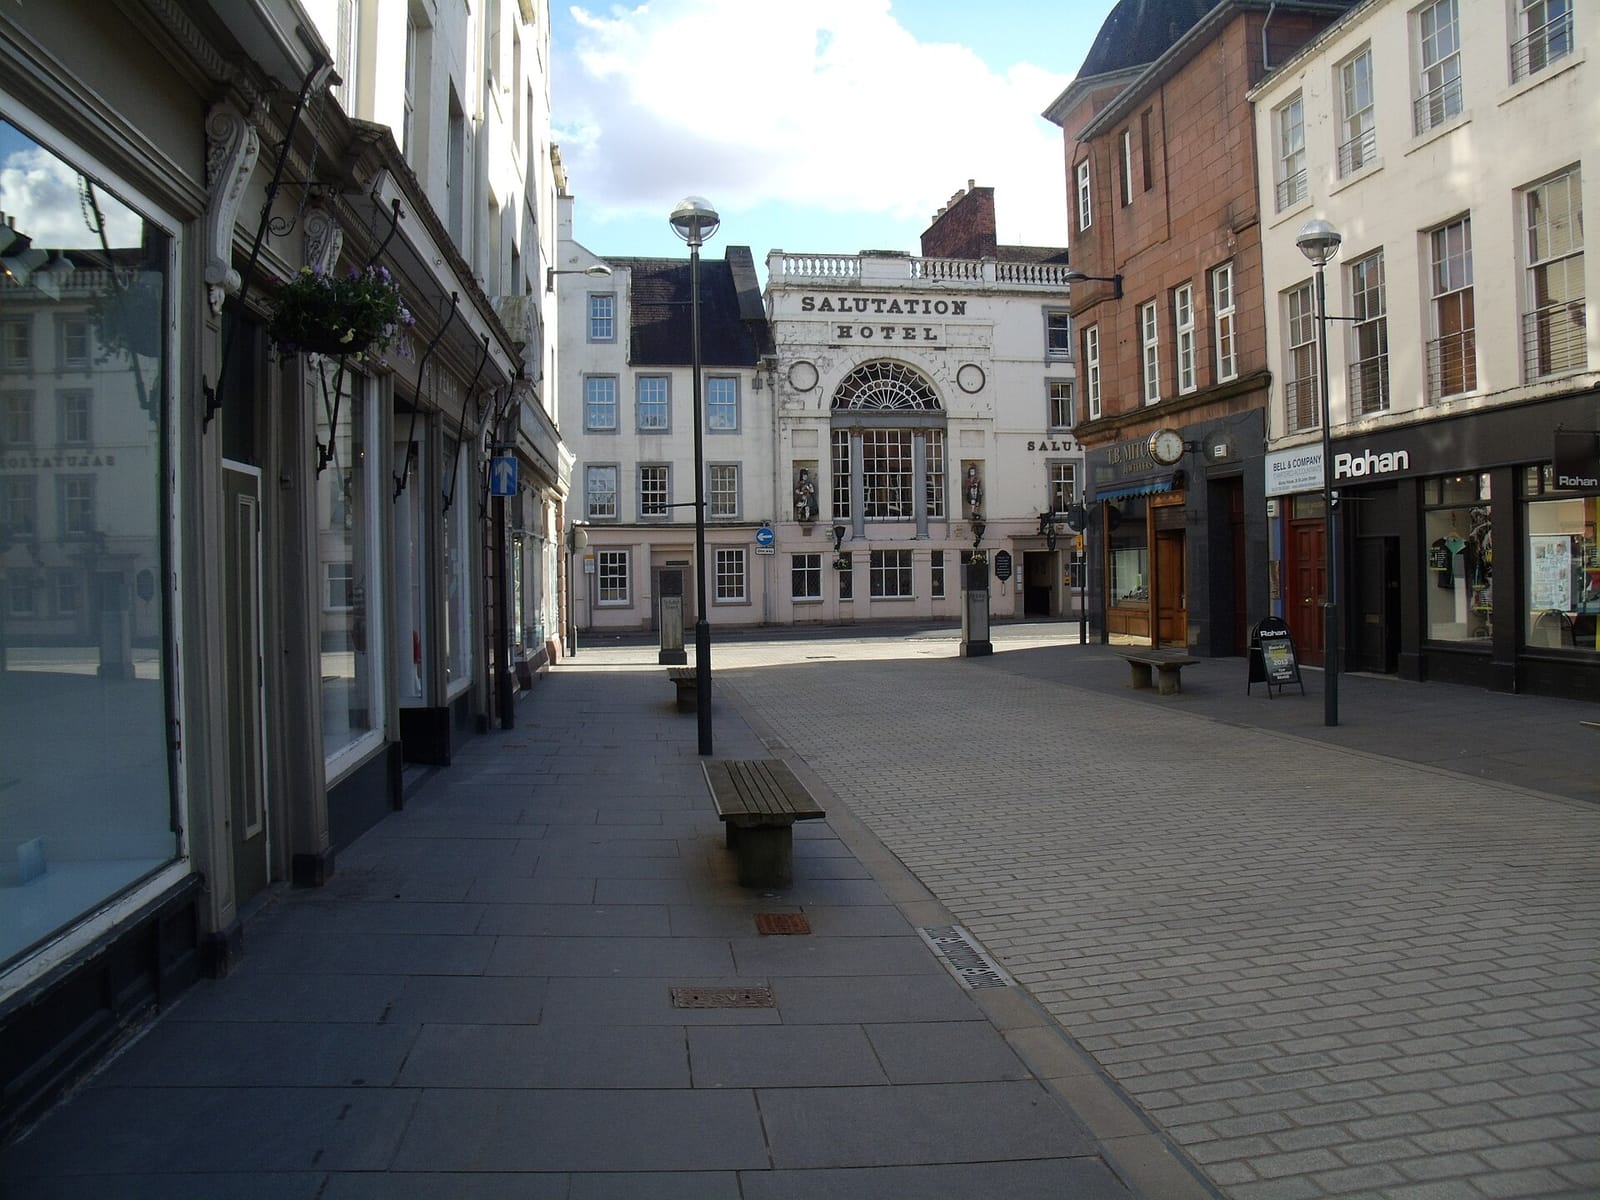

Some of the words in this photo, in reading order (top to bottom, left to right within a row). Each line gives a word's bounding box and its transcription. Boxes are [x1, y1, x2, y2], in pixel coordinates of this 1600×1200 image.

[801, 296, 967, 315] SALUTATION
[837, 325, 938, 341] HOTEL
[1273, 462, 1286, 472] BELL
[1287, 460, 1291, 469] &
[1292, 455, 1322, 469] COMPANY
[1334, 449, 1409, 479] Rohan
[1559, 476, 1598, 486] Rohan
